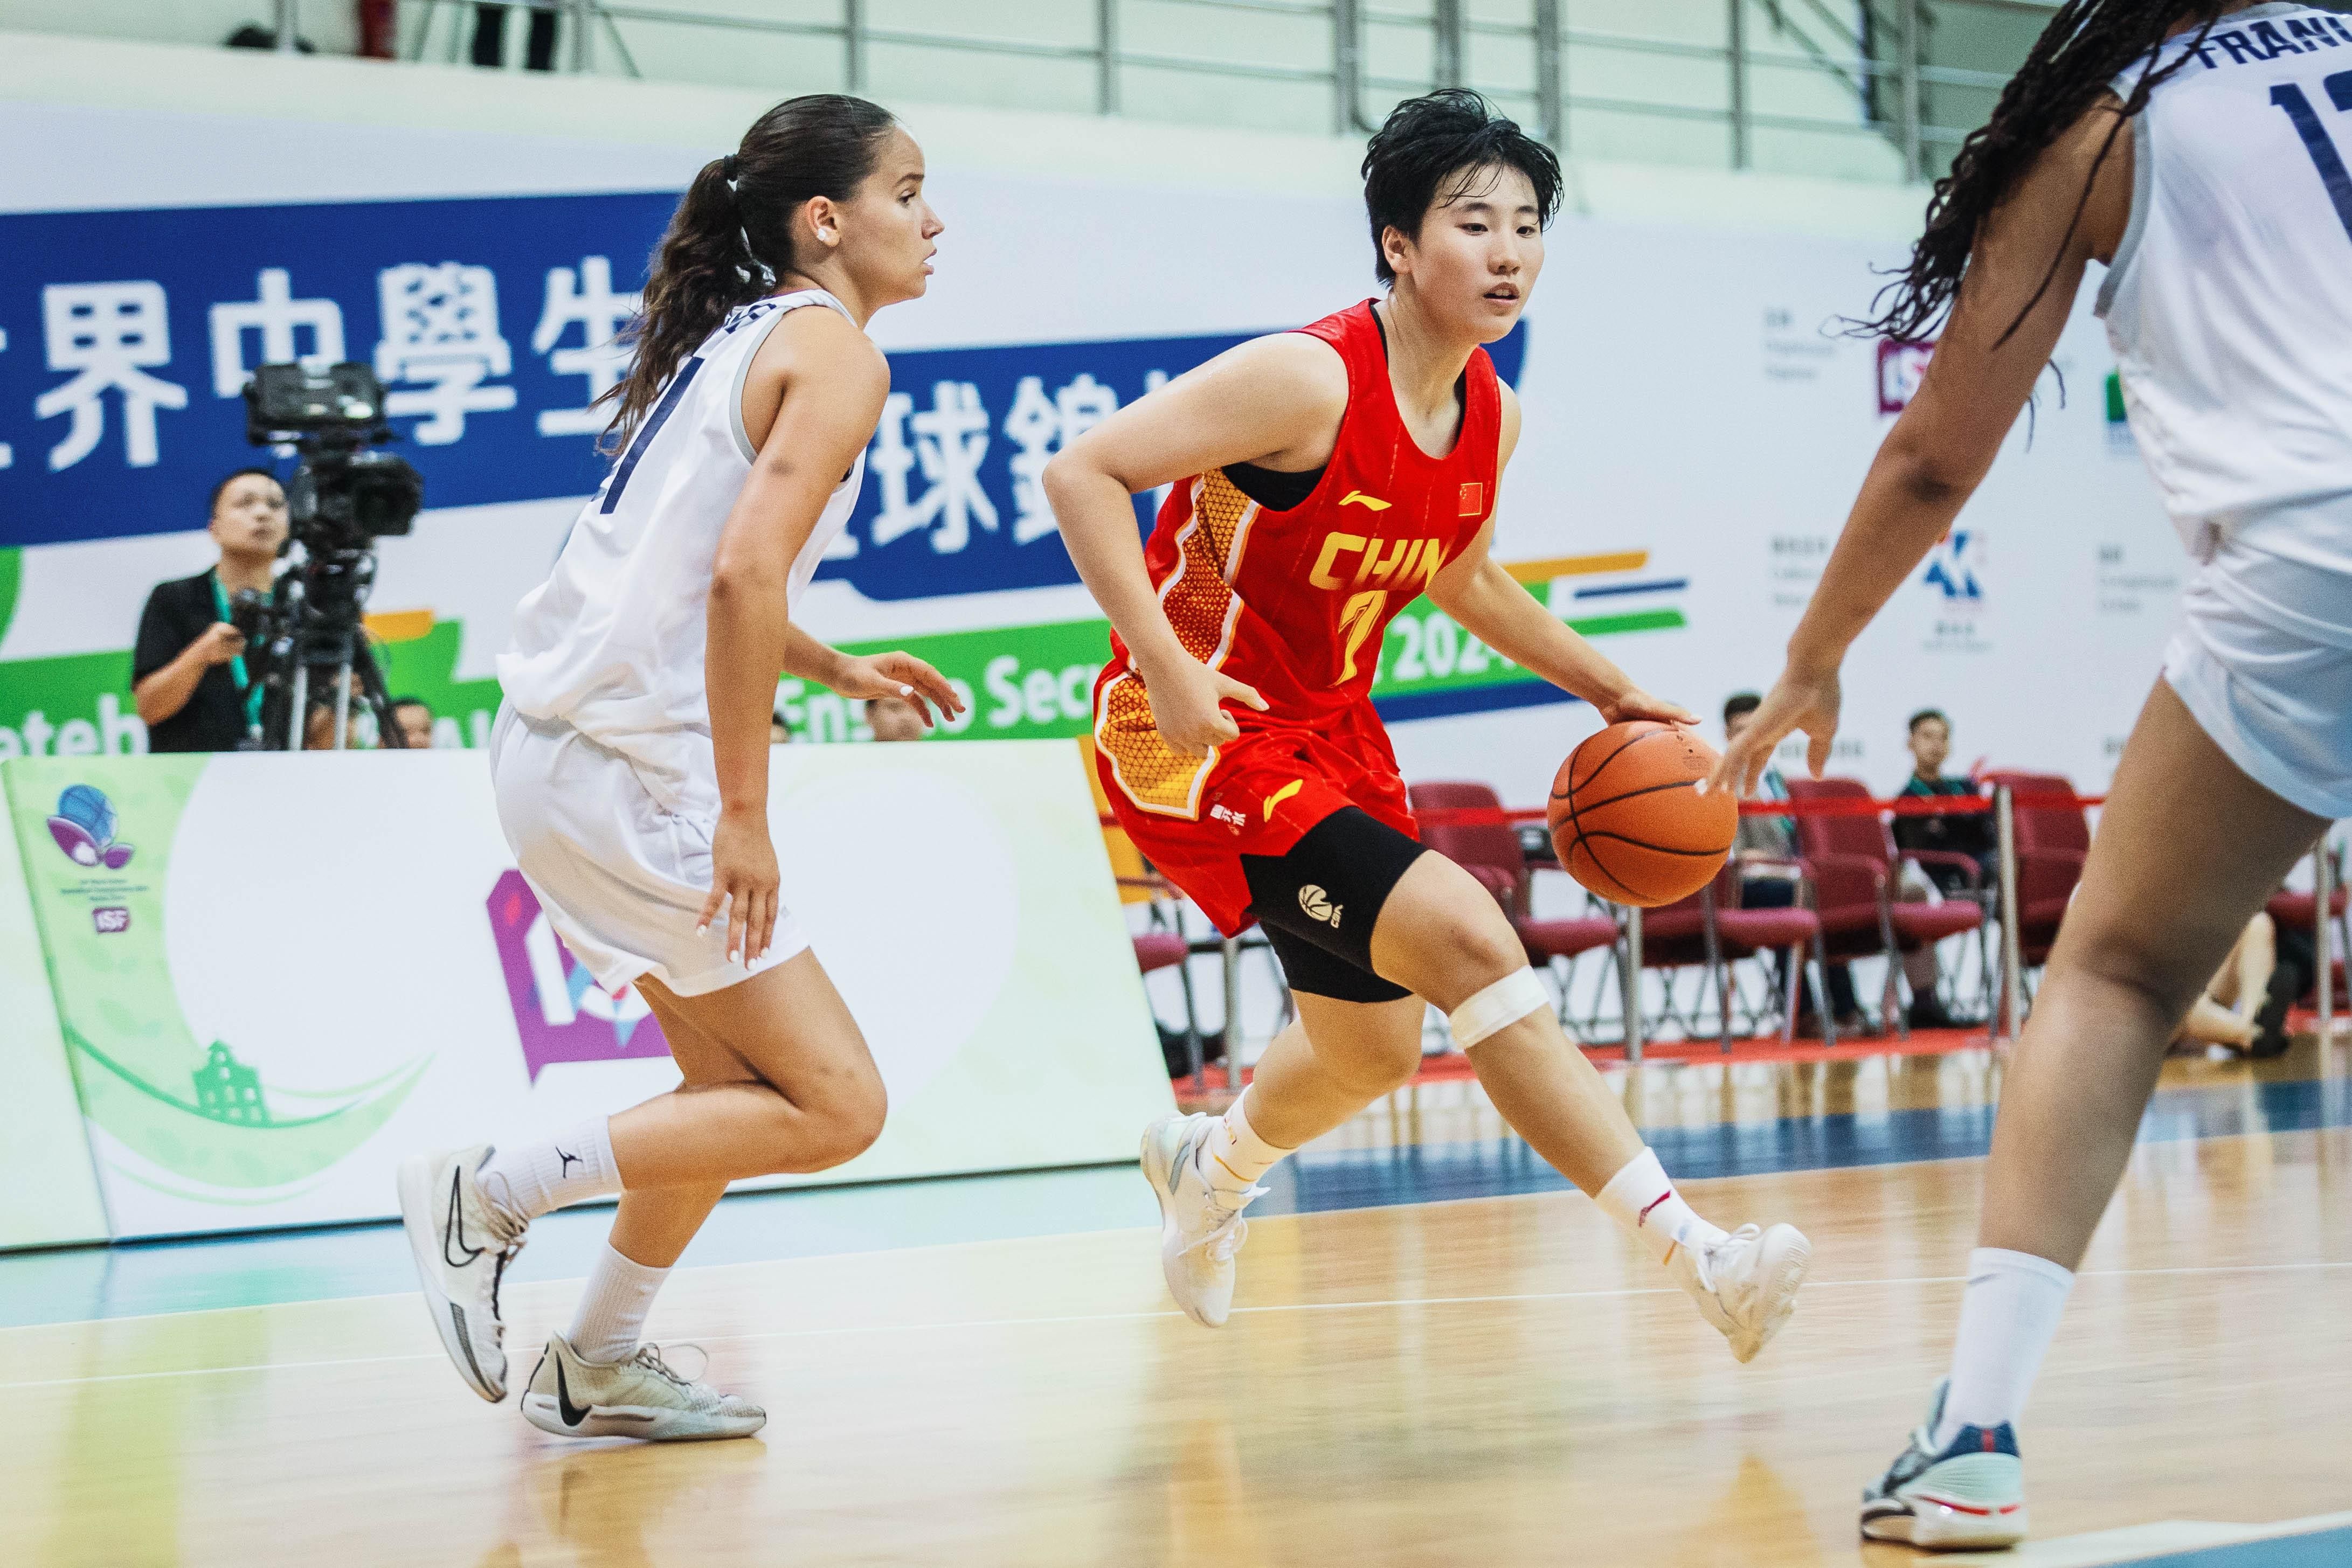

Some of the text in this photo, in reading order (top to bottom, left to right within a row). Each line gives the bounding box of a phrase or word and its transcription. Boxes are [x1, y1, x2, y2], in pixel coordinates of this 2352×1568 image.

[0, 255, 651, 471] 界中學生
[1324, 590, 1388, 688] 7
